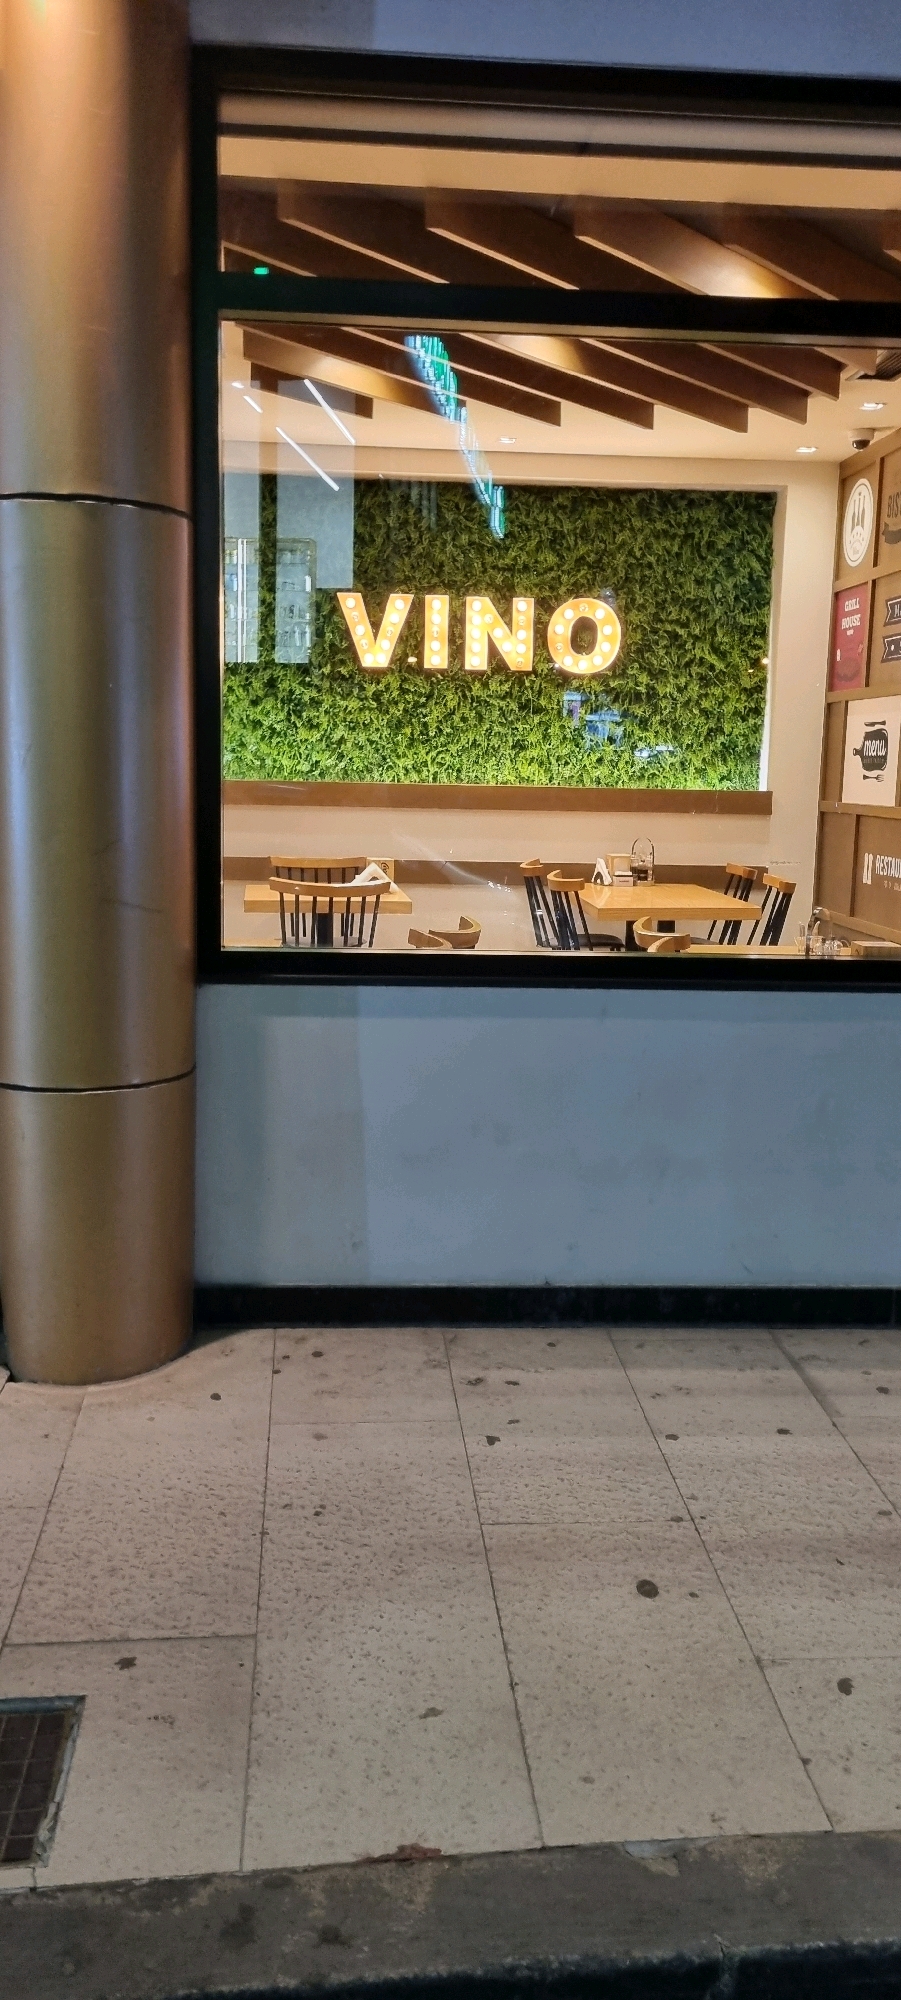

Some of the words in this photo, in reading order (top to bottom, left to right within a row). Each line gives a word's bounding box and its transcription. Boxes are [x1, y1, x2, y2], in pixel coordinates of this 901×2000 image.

[887, 492, 901, 518] BIS
[841, 613, 861, 630] HOUSE
[337, 592, 622, 674] VINO
[863, 739, 887, 756] menu
